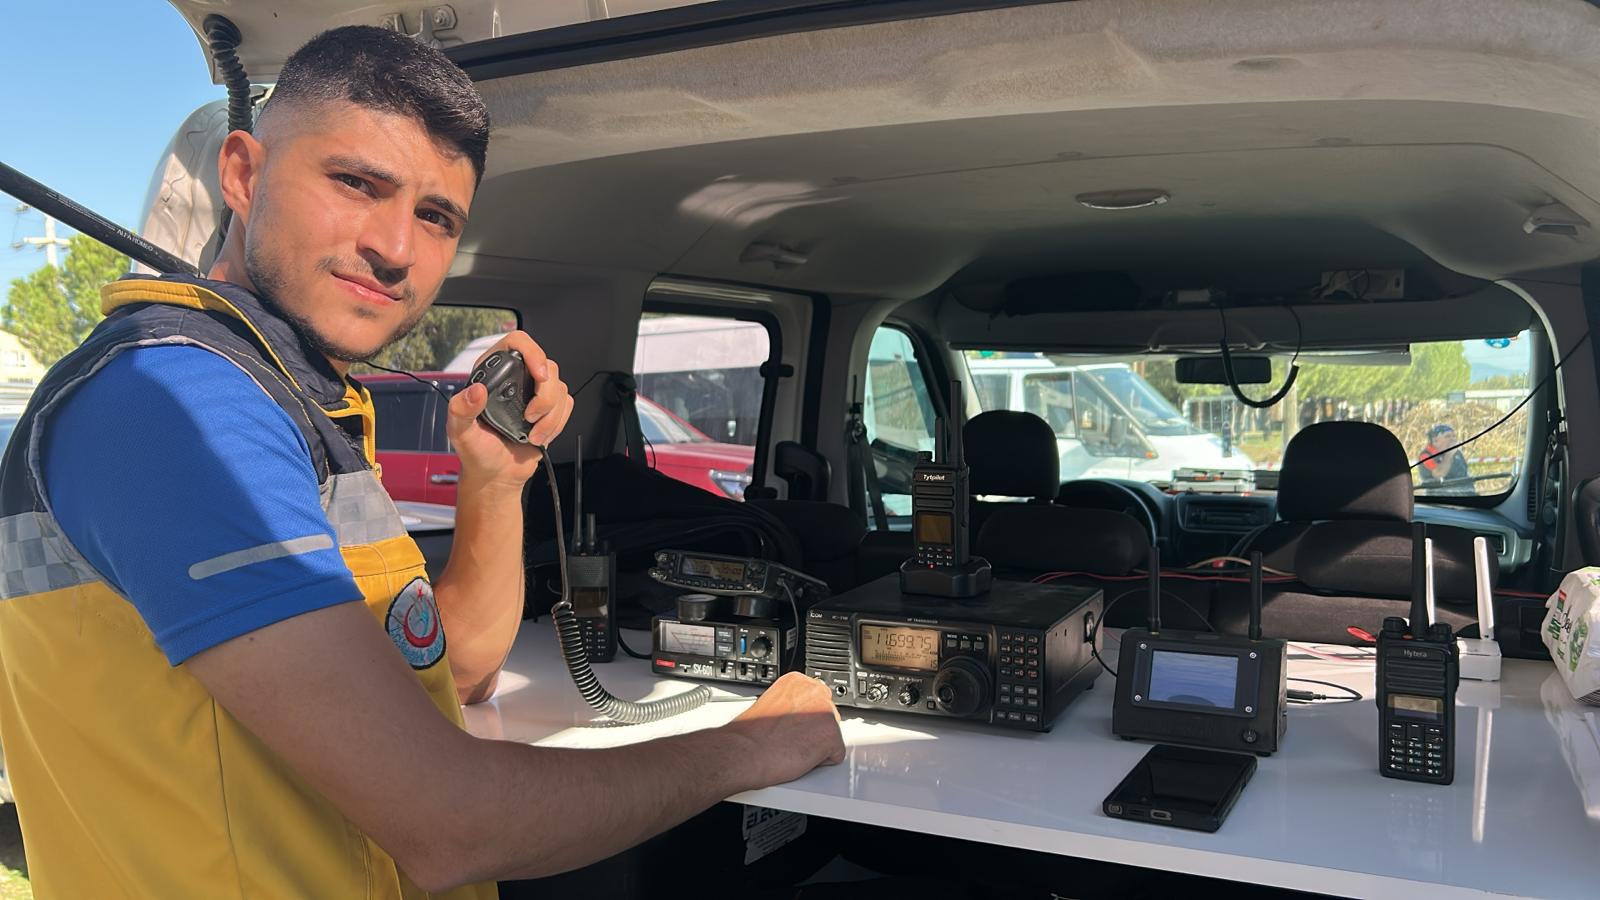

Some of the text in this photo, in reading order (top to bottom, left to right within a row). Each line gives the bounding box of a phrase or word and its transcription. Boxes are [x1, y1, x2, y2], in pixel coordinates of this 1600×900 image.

[117, 229, 154, 252] ALFA ROMEO
[923, 474, 945, 482] Tytpilot
[1403, 649, 1428, 658] Hytera
[693, 663, 713, 676] SX-601
